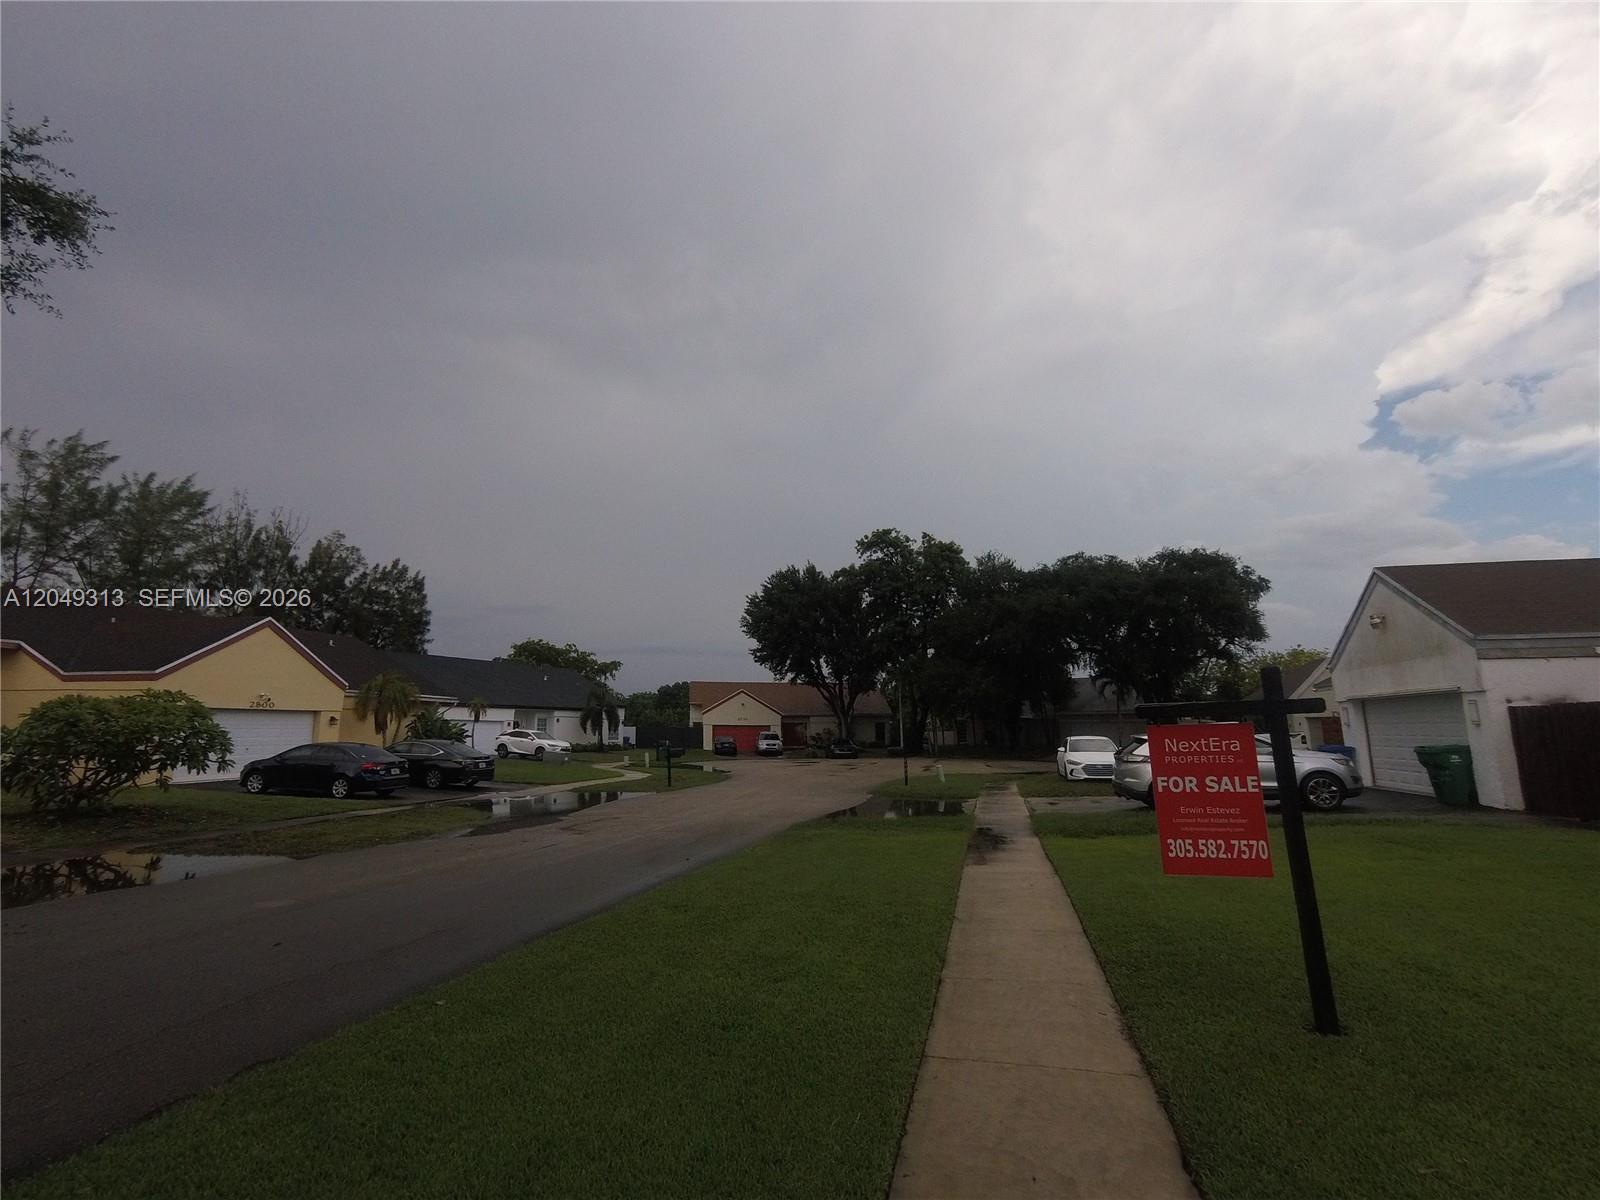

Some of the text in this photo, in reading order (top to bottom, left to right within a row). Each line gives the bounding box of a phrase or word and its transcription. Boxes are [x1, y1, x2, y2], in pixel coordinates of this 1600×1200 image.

[1164, 737, 1240, 752] NextEra
[1165, 754, 1234, 764] PROPERTIES
[1157, 776, 1260, 793] FOR SALE
[1180, 806, 1240, 815] Erwin Estevez
[1167, 838, 1269, 860] 305.582.7570
